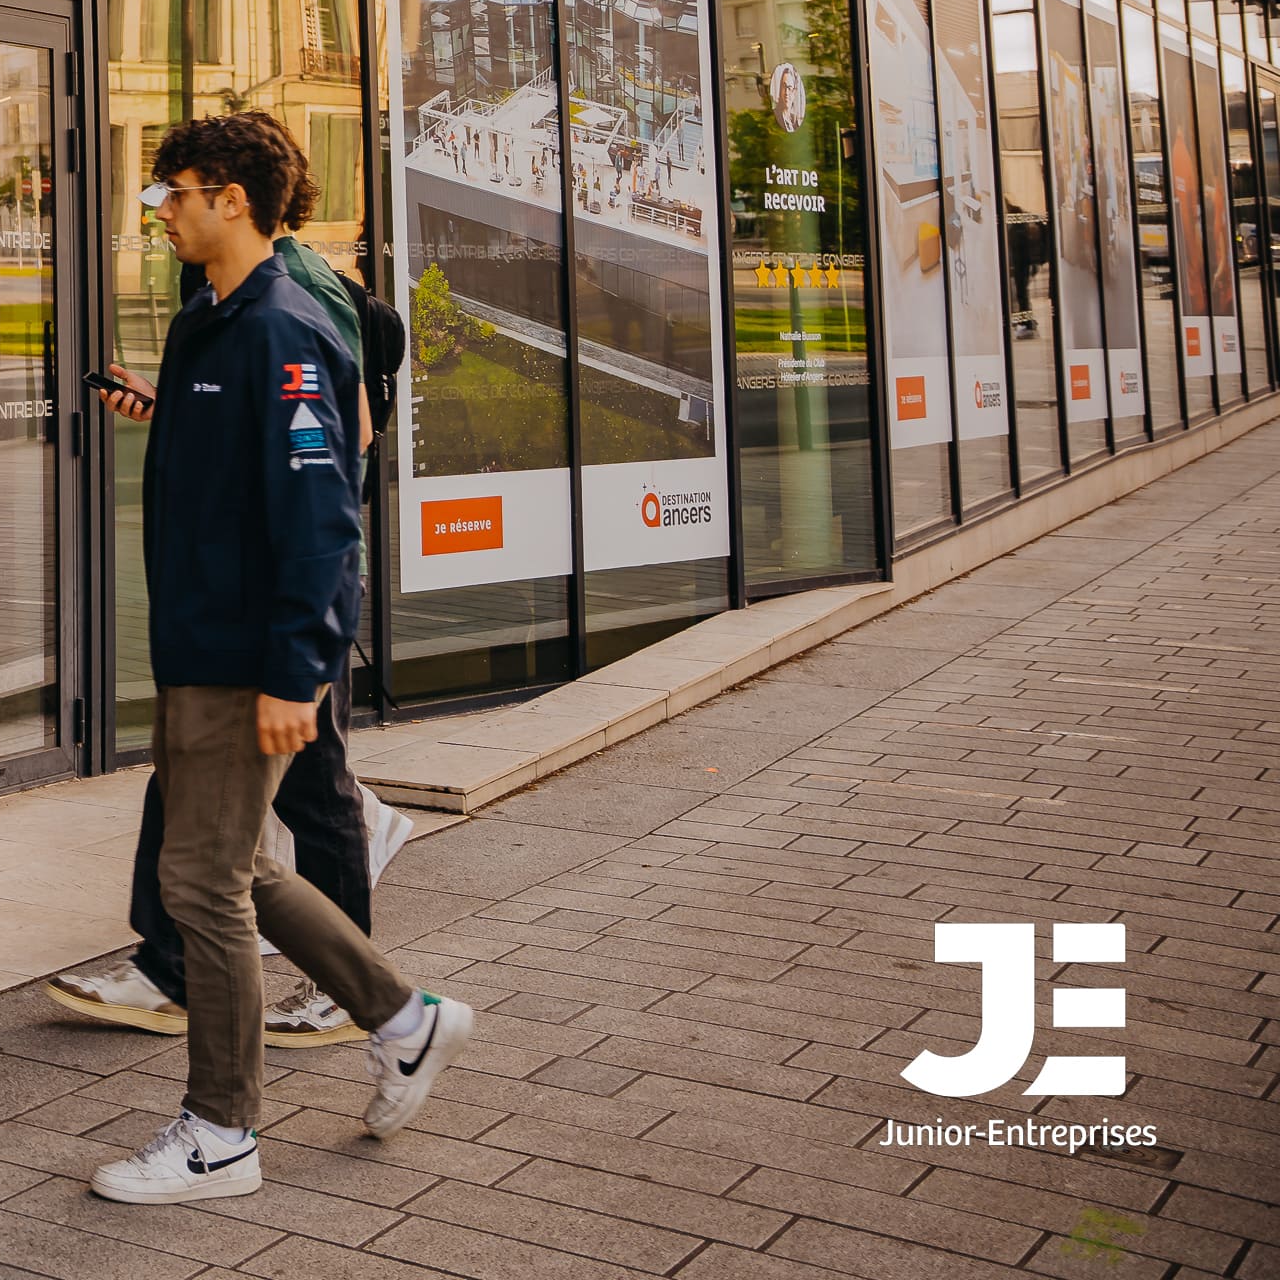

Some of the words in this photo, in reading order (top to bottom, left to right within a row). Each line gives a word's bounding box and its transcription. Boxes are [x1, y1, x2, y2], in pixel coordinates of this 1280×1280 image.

[36, 232, 51, 250] DE
[281, 363, 320, 392] JE
[35, 399, 53, 418] DE
[662, 491, 712, 506] DESTINATION
